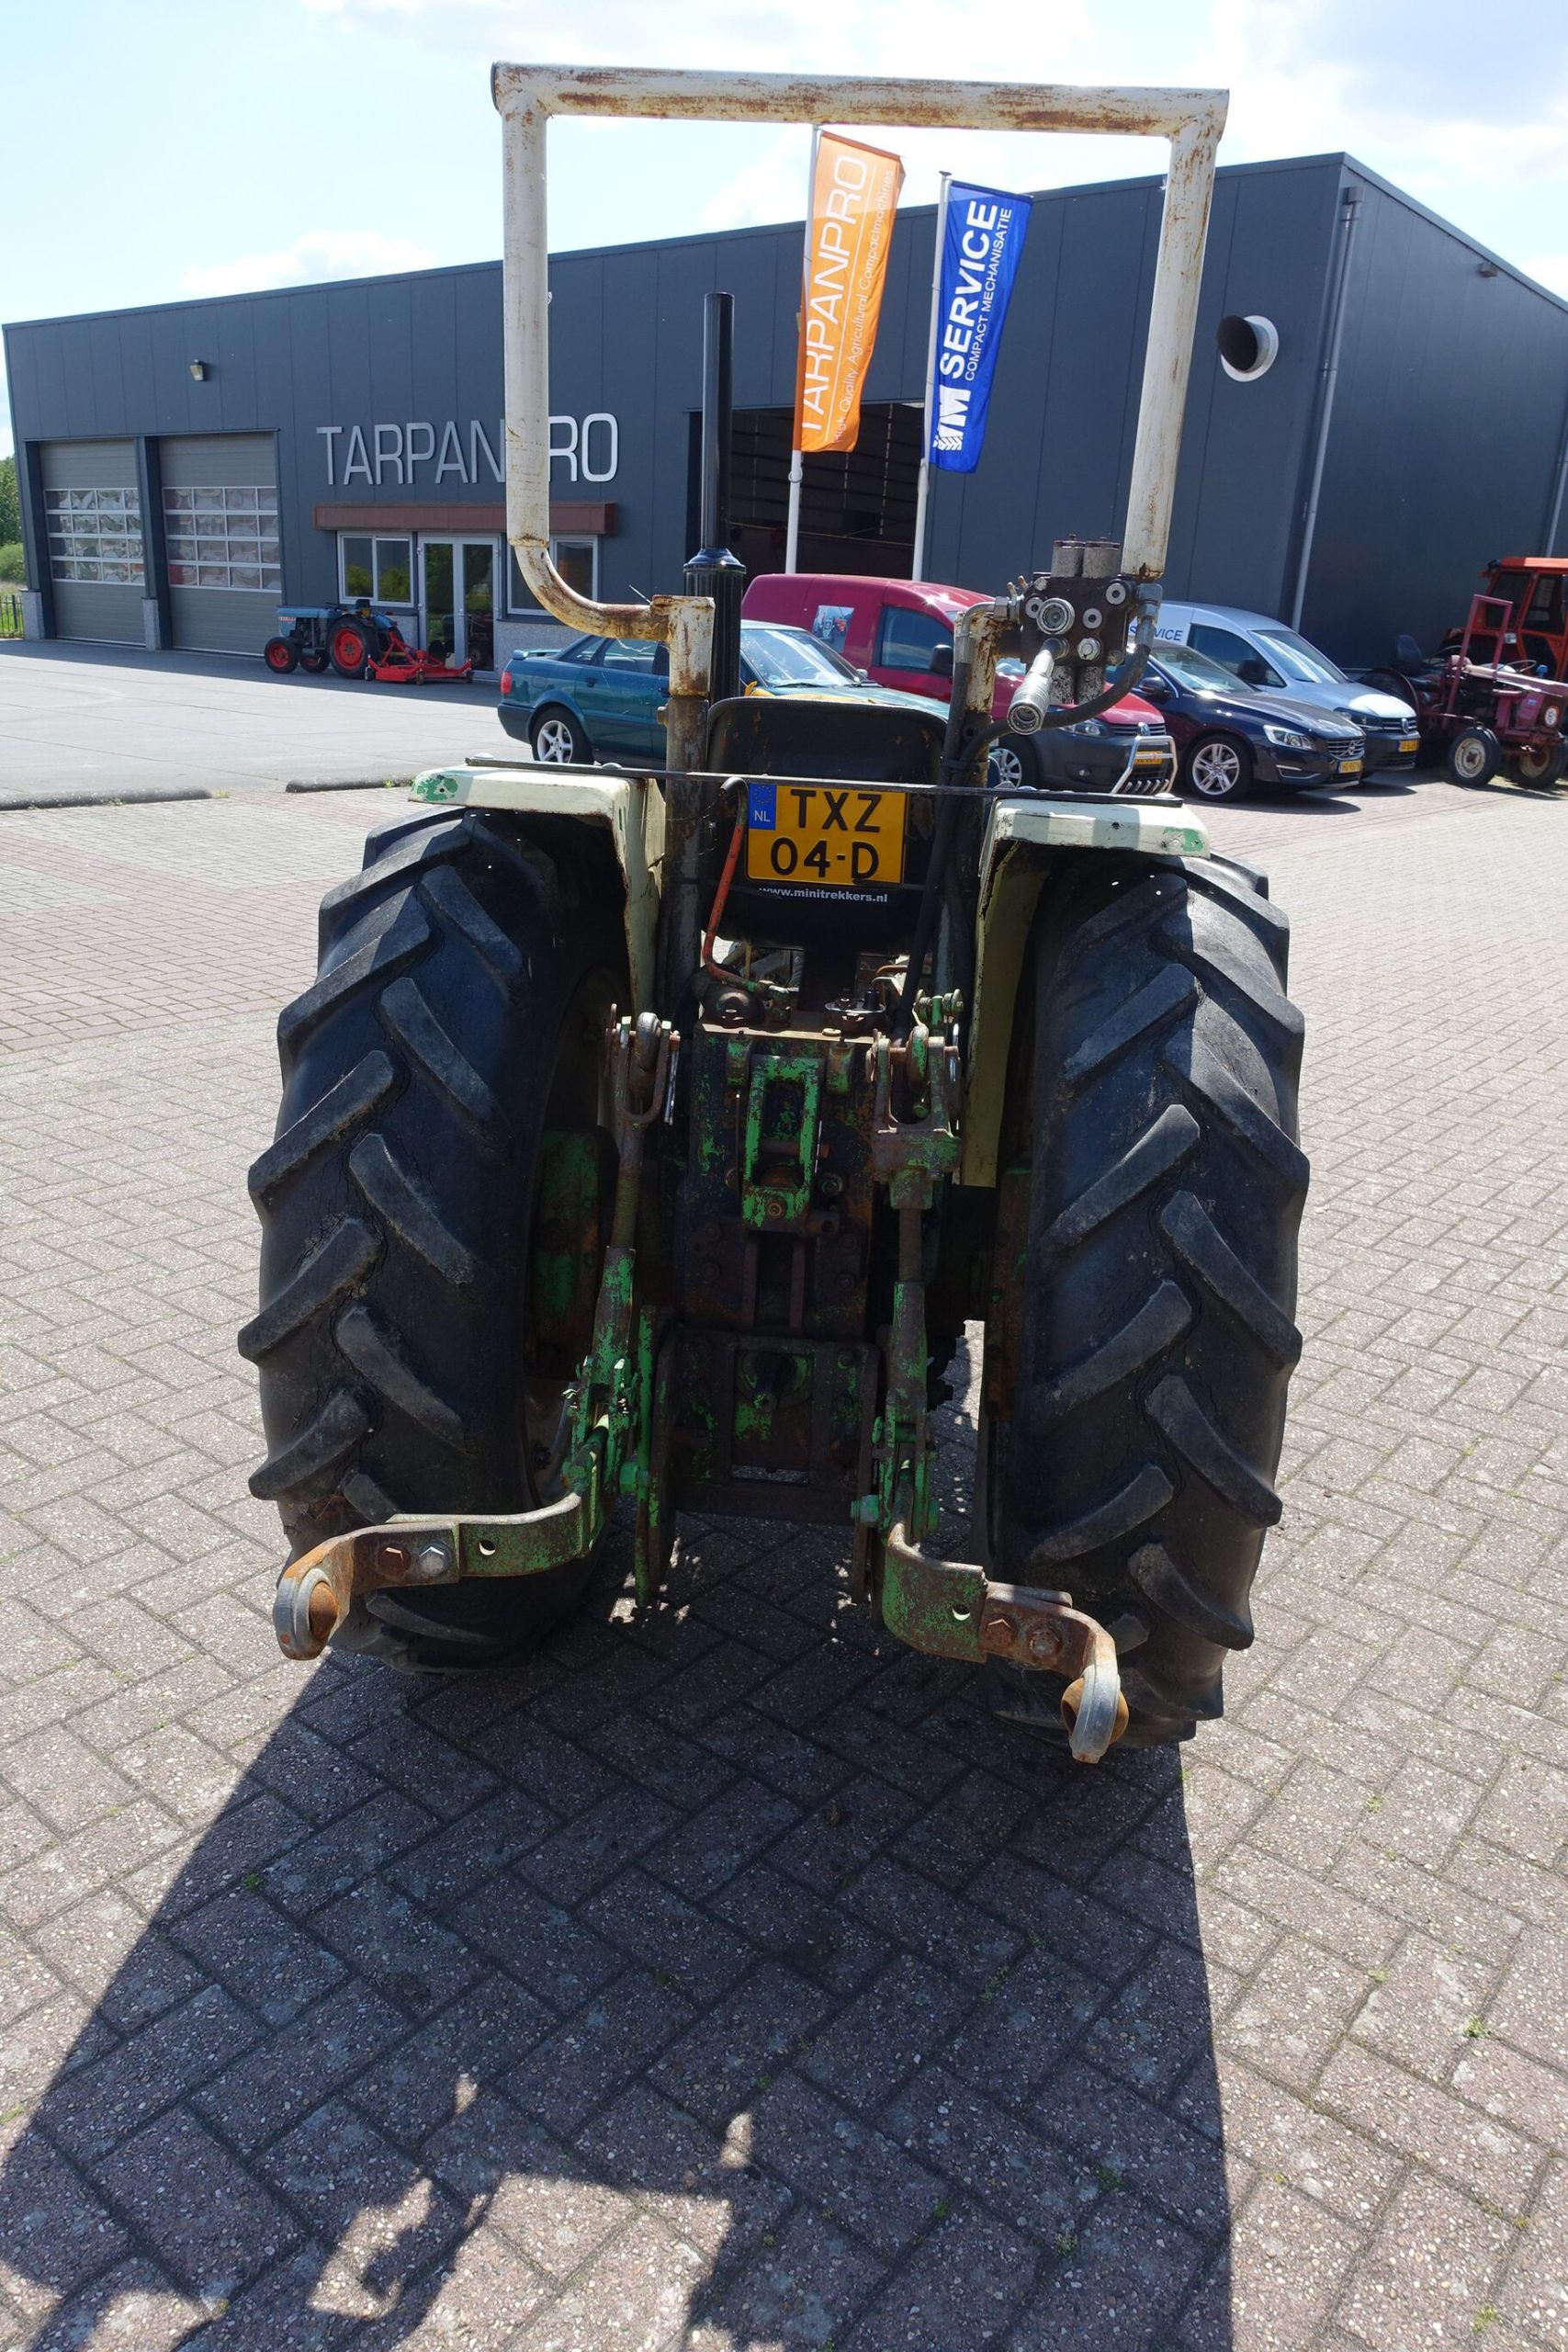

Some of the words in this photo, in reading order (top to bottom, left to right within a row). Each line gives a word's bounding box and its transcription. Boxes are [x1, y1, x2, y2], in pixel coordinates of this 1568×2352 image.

[858, 170, 894, 289] Compactmachines
[939, 200, 998, 379] SERVICE
[964, 315, 989, 381] COMPACT
[981, 208, 1012, 312] MECHANISATIE
[847, 294, 869, 366] Agricultural
[839, 368, 860, 413] Quality
[316, 413, 618, 485] TARPANRO
[1129, 625, 1183, 641] SVICE
[754, 809, 771, 822] NL
[790, 788, 882, 833] TXZ
[770, 837, 879, 879] 04-D
